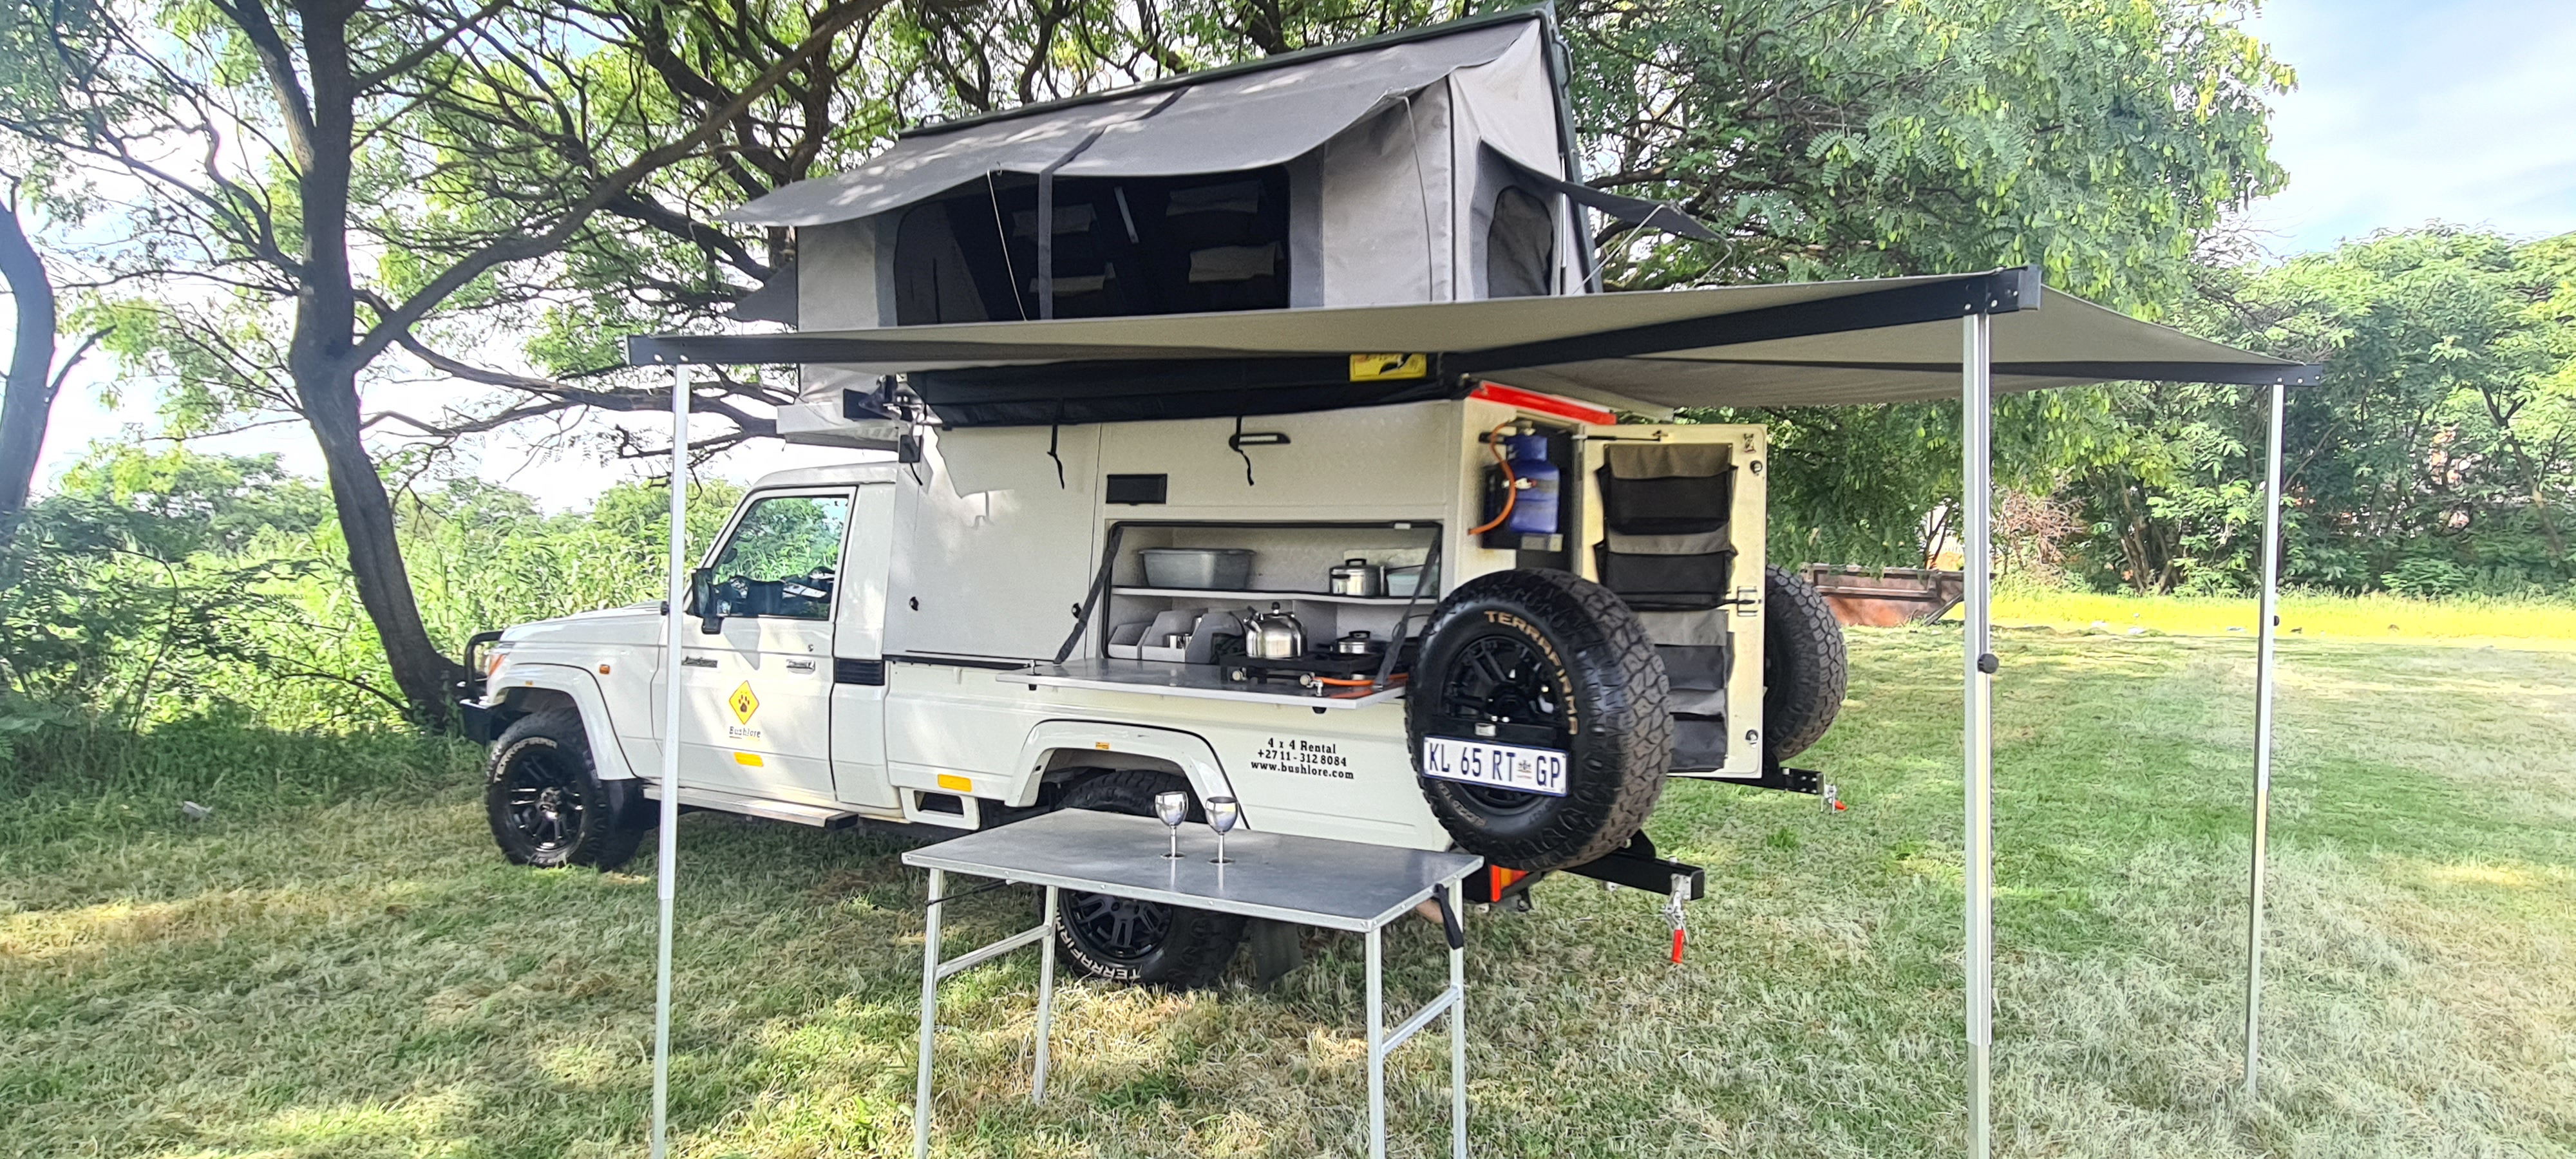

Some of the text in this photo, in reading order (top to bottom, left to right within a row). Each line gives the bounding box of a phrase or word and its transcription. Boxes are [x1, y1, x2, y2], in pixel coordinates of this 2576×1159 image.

[1484, 611, 1578, 735] TERRAFIRMA
[1267, 737, 1274, 748] 4
[1289, 740, 1295, 750] 4
[1300, 740, 1336, 753] Rental
[1251, 762, 1354, 779] www.bushlore.com
[1429, 742, 1560, 787] KL 65 RT GP
